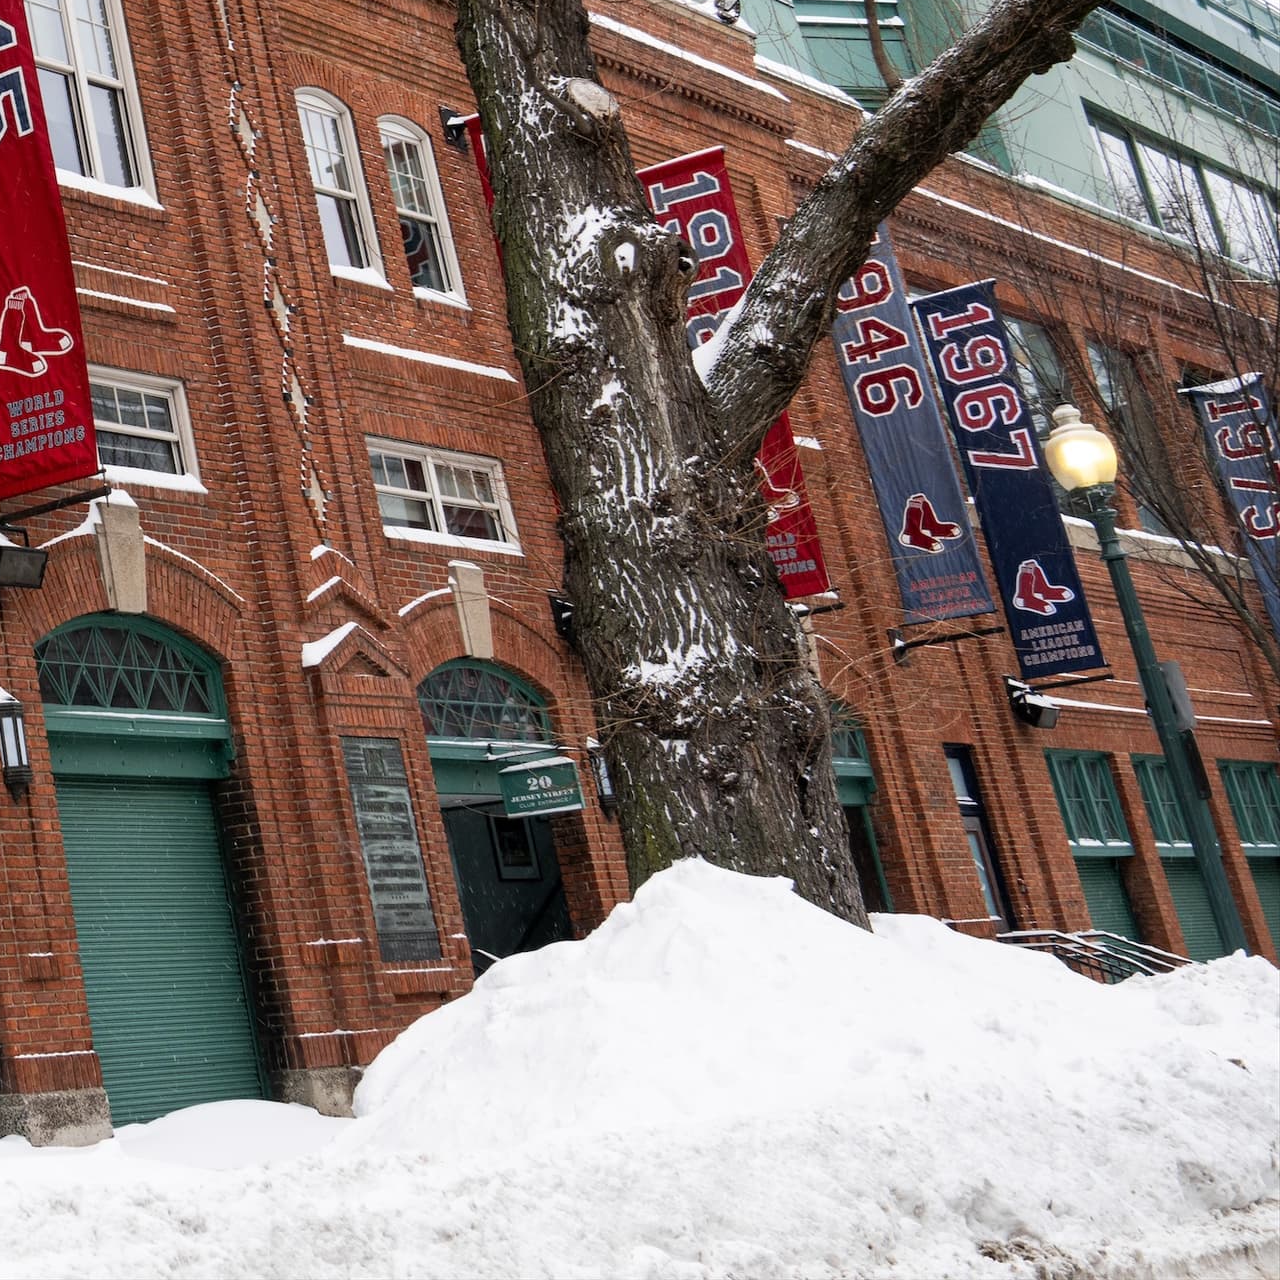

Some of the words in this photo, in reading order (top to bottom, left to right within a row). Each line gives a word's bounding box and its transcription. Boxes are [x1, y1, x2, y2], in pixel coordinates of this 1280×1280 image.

[836, 231, 925, 417] 946
[927, 302, 1039, 470] 1967
[6, 389, 64, 418] WORLD
[10, 410, 65, 438] SERIES
[1020, 619, 1085, 640] AMERICAN
[1032, 634, 1079, 652] LEAGUE
[1023, 645, 1095, 666] CHAMPIONS
[526, 775, 552, 791] 20
[511, 793, 541, 803] JERSEY
